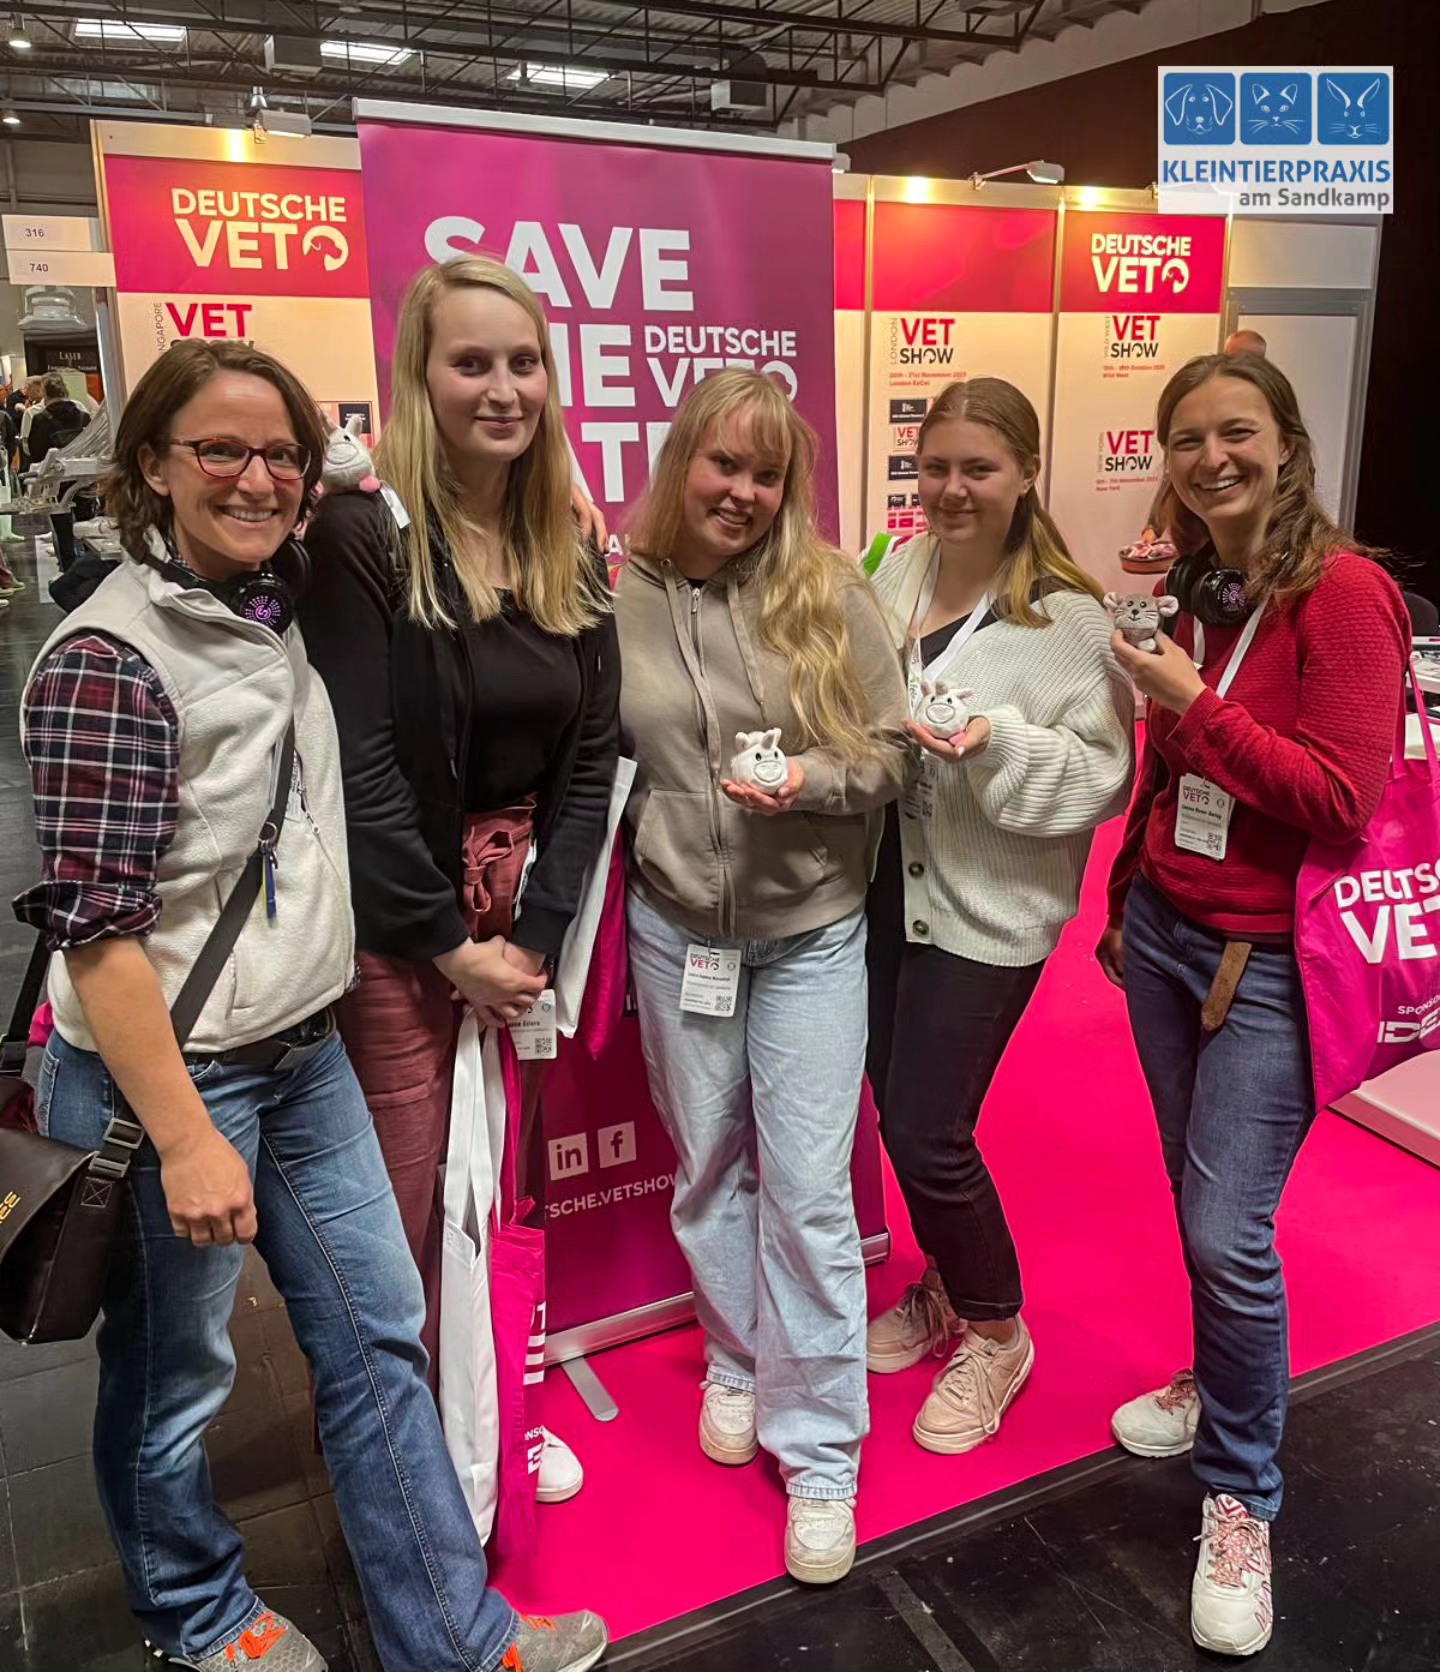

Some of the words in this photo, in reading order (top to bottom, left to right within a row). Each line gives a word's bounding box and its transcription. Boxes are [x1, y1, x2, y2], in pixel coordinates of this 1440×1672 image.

[171, 188, 347, 222] DEUTSCHE
[25, 228, 45, 237] 316
[175, 218, 298, 270] VET
[1091, 233, 1192, 256] DEUTSCHE
[30, 263, 49, 272] 740
[424, 216, 694, 311] SAVE
[1091, 256, 1162, 293] VET
[154, 302, 166, 351] NGAPORE
[165, 302, 252, 337] VET
[900, 318, 956, 346] VET
[1112, 315, 1161, 341] VET
[644, 325, 797, 357] DEUTSCHE
[890, 317, 898, 365] LONDON
[900, 348, 954, 364] SHOW
[1110, 342, 1158, 358] SHOW
[1106, 430, 1154, 455] VET
[1104, 455, 1152, 472] SHOW
[1334, 859, 1440, 909] DEUTS
[545, 1173, 676, 1218] SCHE.VETSHO
